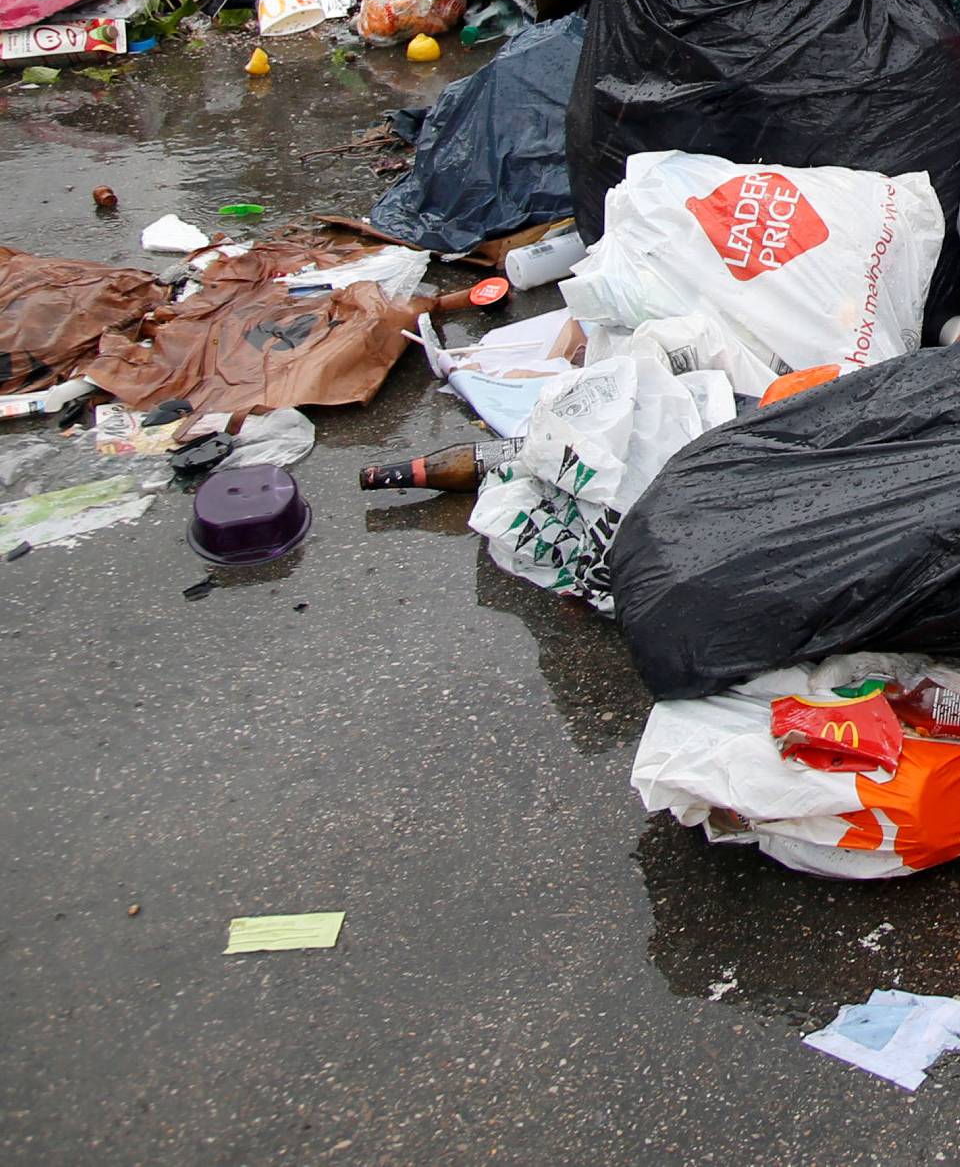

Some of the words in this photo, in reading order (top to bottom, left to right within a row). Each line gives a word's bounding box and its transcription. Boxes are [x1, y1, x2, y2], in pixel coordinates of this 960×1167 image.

[724, 173, 773, 268] LEADER
[759, 187, 800, 267] PRICE
[845, 319, 875, 369] hoix
